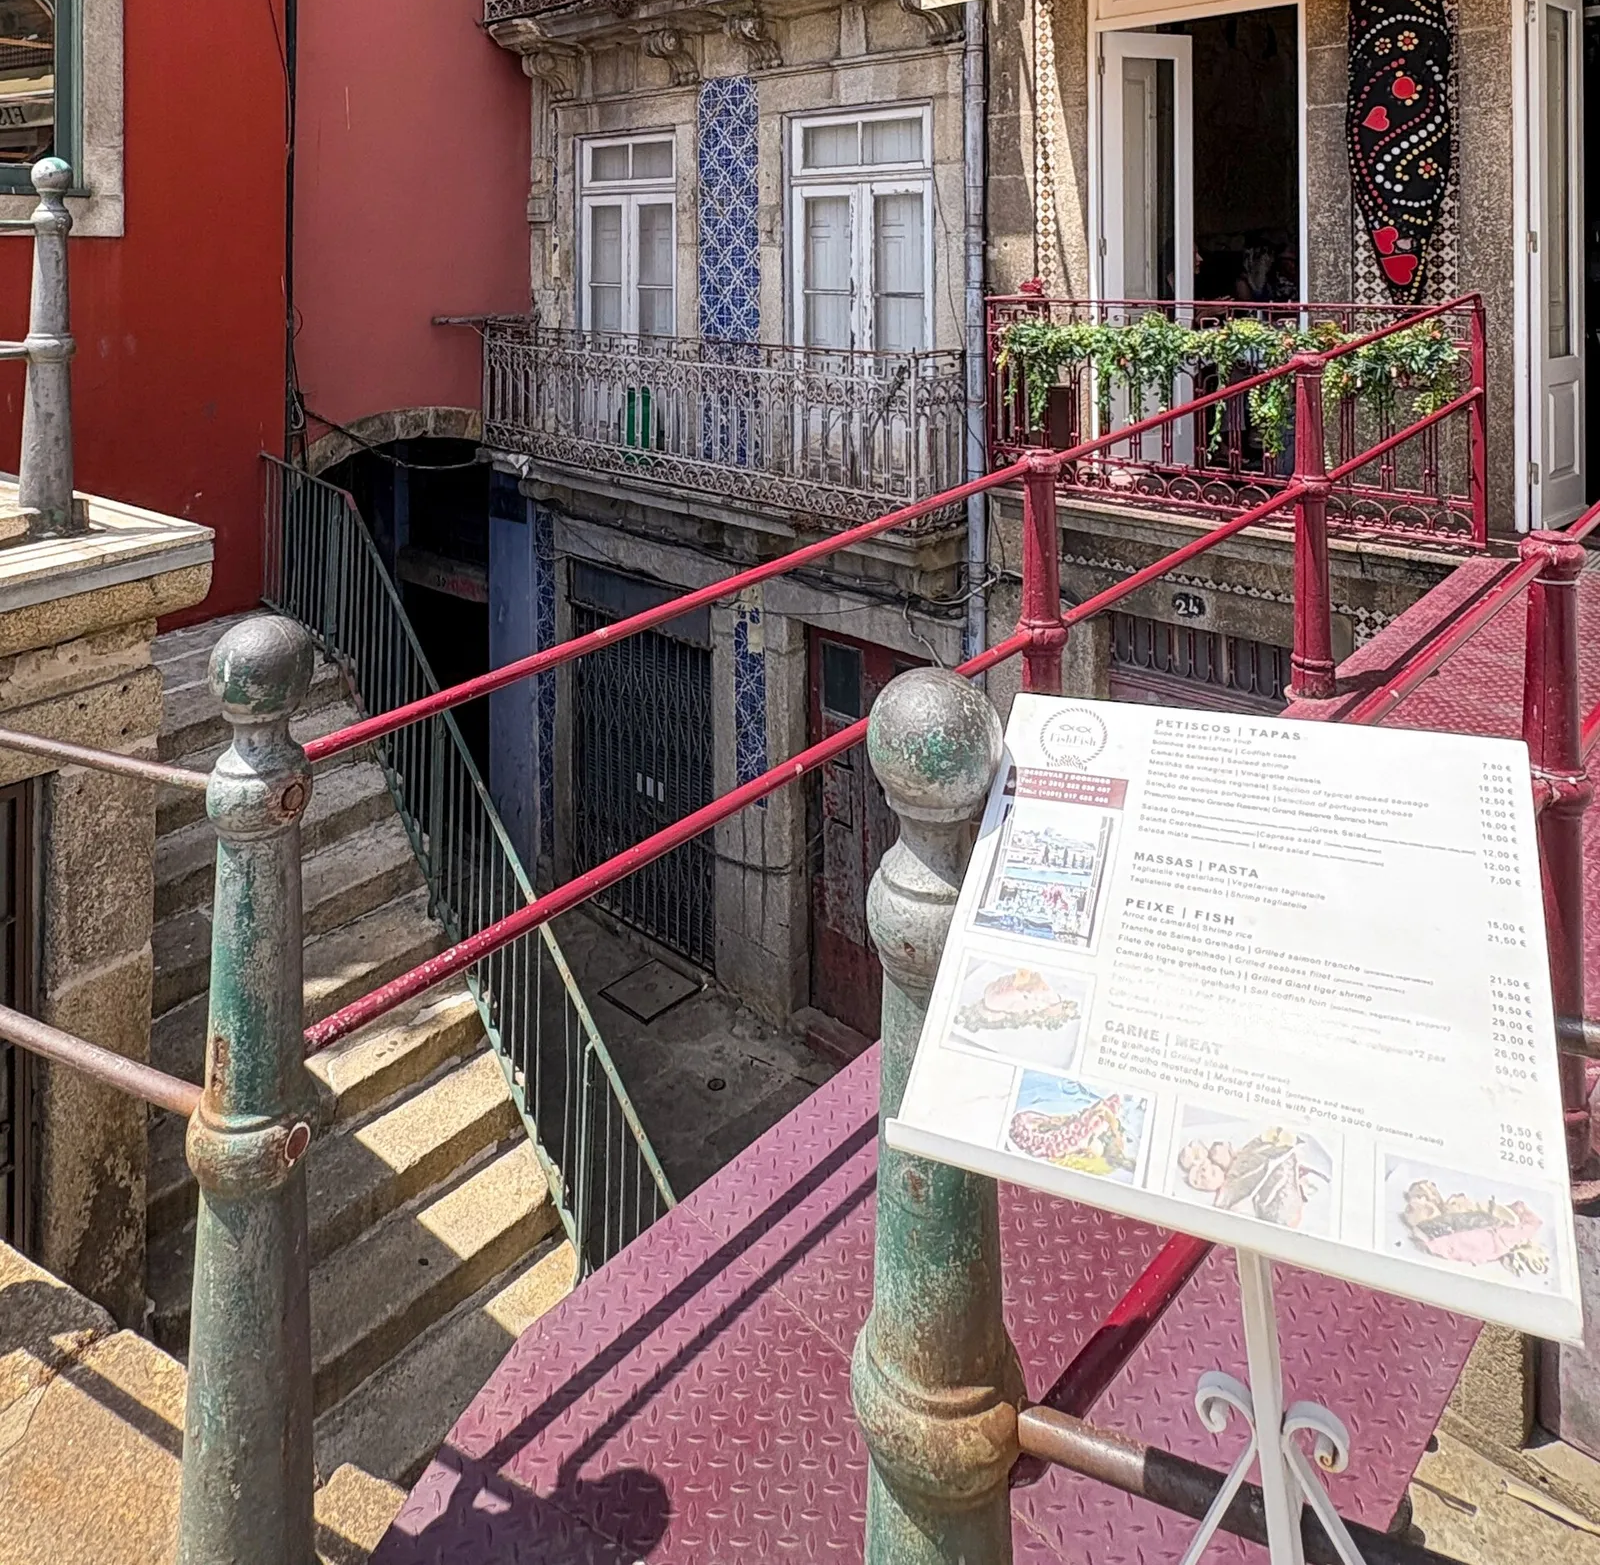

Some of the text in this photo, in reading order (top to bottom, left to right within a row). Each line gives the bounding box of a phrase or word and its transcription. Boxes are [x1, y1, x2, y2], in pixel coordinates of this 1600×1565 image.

[1175, 598, 1199, 614] 24
[1156, 719, 1300, 740] PETISCOS TAPAS
[1050, 732, 1096, 746] FishFish
[1145, 779, 1176, 789] Seleção
[1221, 790, 1270, 801] portugueses
[1328, 803, 1377, 813] portuguese
[1148, 769, 1177, 778] Seleção
[1272, 784, 1310, 794] Selection
[1324, 791, 1352, 799] typical
[1355, 795, 1388, 803] smoked
[1391, 799, 1428, 808] sausage
[1206, 798, 1234, 807] Grande
[1272, 806, 1296, 815] Grand
[1483, 849, 1509, 858] 12,00
[1134, 851, 1258, 878] MASSAS PASTA
[1484, 862, 1510, 872] 12,00
[1490, 875, 1511, 885] 7,00
[1186, 885, 1222, 895] camarão
[1125, 898, 1234, 925] PEIXE FISH
[1122, 910, 1144, 920] Arroz
[1202, 924, 1232, 936] Shrimp
[1118, 934, 1141, 944] Filete
[1157, 942, 1184, 953] robalo
[1187, 949, 1225, 961] grelhado
[1235, 956, 1266, 968] Grilled
[1268, 964, 1306, 976] seabass
[1121, 922, 1153, 934] Tranche
[1170, 931, 1202, 943] Salmão
[1204, 938, 1245, 951] Grelhado
[1254, 947, 1285, 958] Grilled
[1288, 954, 1321, 965] salmon
[1324, 960, 1360, 972] tranche
[1115, 946, 1153, 960] Camarão
[1156, 955, 1175, 964] tigre
[1178, 960, 1217, 973] grelhado
[1251, 973, 1282, 985] Grilled
[1285, 979, 1311, 990] Giant
[1313, 985, 1336, 994] tiger
[1339, 990, 1372, 1002] shrimp
[1490, 975, 1519, 987] 21,50
[1201, 978, 1240, 991] grelhado
[1271, 992, 1305, 1003] codfish
[1308, 998, 1326, 1007] loin
[1492, 990, 1520, 1001] 19,50
[1492, 1003, 1521, 1015] 19,50
[1105, 1020, 1159, 1042] CARNE
[1492, 1017, 1522, 1030] 29,00
[1102, 1034, 1119, 1045] Bife
[1122, 1040, 1160, 1055] grelhado
[1492, 1032, 1523, 1045] 23,00
[1494, 1048, 1525, 1062] 26,00
[1100, 1045, 1117, 1056] Bife
[1130, 1054, 1158, 1066] molho
[1161, 1061, 1204, 1077] mostarda
[1213, 1072, 1252, 1088] Mustard
[1256, 1083, 1281, 1094] steak
[1098, 1057, 1115, 1067] Bife
[1129, 1066, 1156, 1078] molho
[1159, 1073, 1170, 1081] de
[1174, 1076, 1199, 1088] vinho
[1202, 1082, 1214, 1091] do
[1217, 1085, 1243, 1098] Porto
[1254, 1094, 1281, 1107] Steak
[1285, 1103, 1306, 1112] with
[1309, 1106, 1337, 1120] Porto
[1341, 1115, 1372, 1129] sauce
[1500, 1123, 1531, 1138] 19,50
[1500, 1150, 1533, 1166] 22,00
